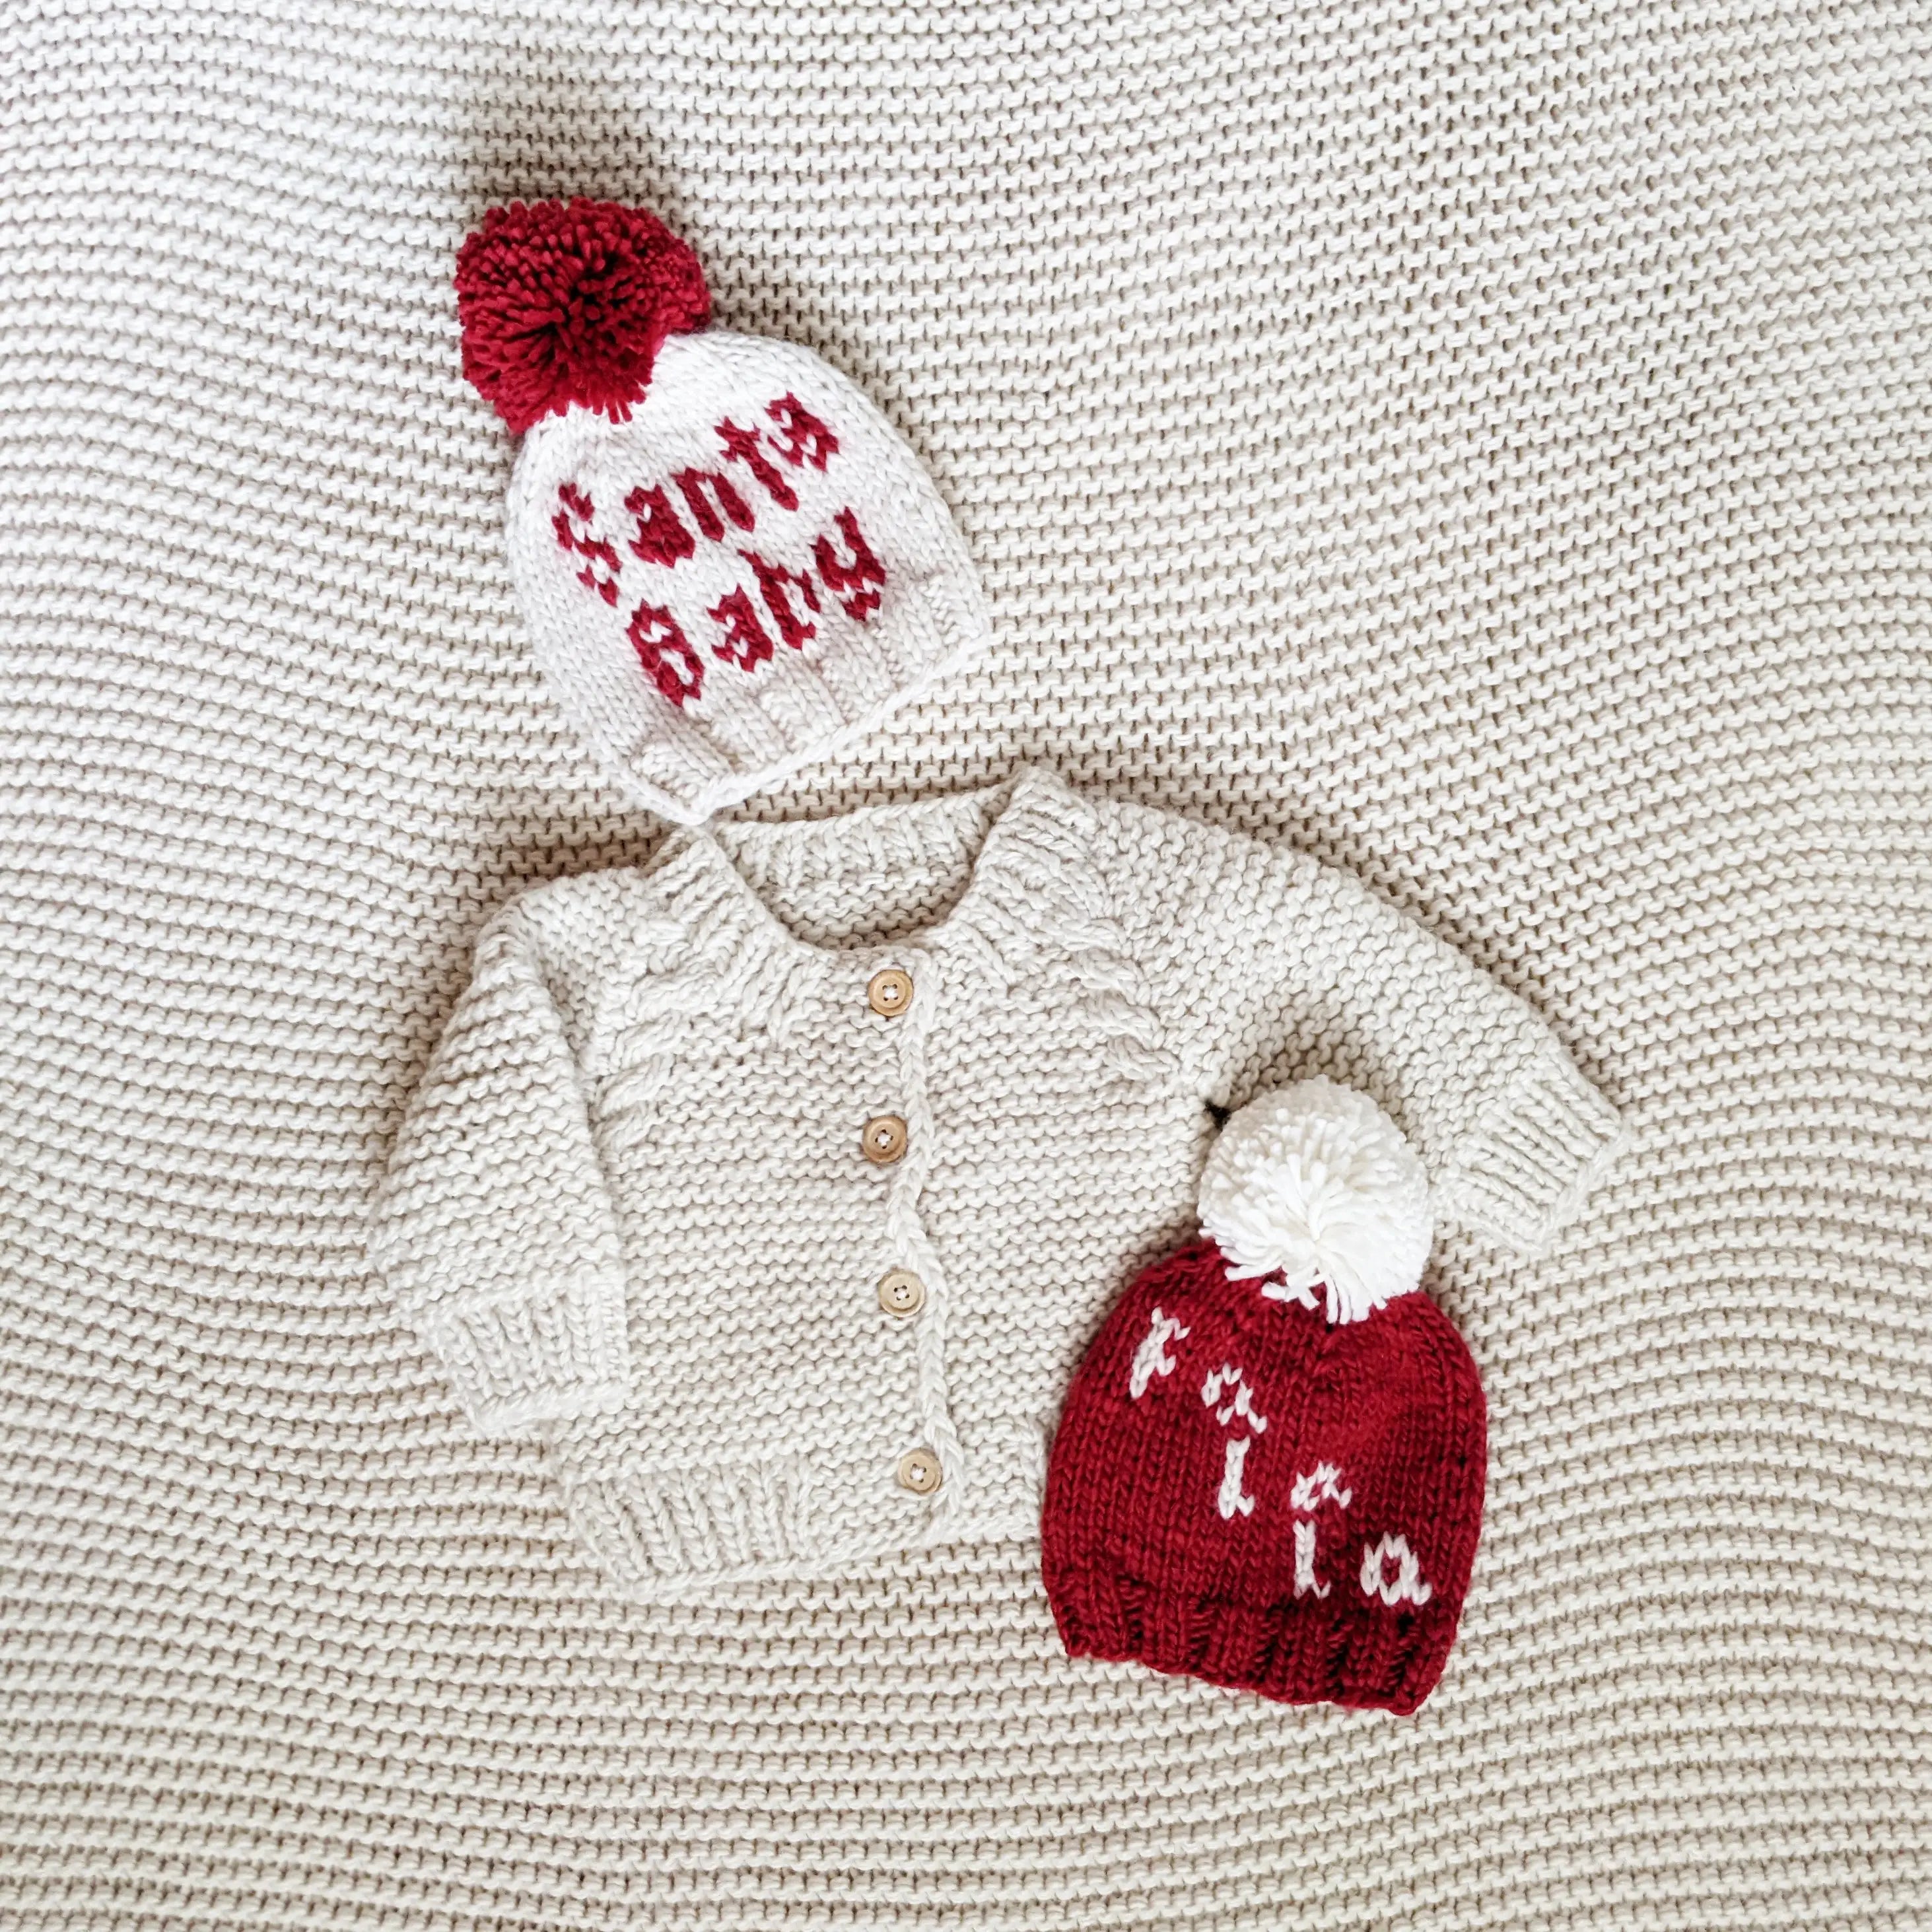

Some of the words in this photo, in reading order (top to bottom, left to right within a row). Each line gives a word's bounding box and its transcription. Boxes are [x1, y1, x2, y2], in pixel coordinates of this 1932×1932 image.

[551, 391, 839, 607] Santa
[625, 506, 887, 707] Baby
[1128, 1306, 1268, 1433] Fa
[1217, 1436, 1352, 1519] la
[1292, 1519, 1433, 1606] la
